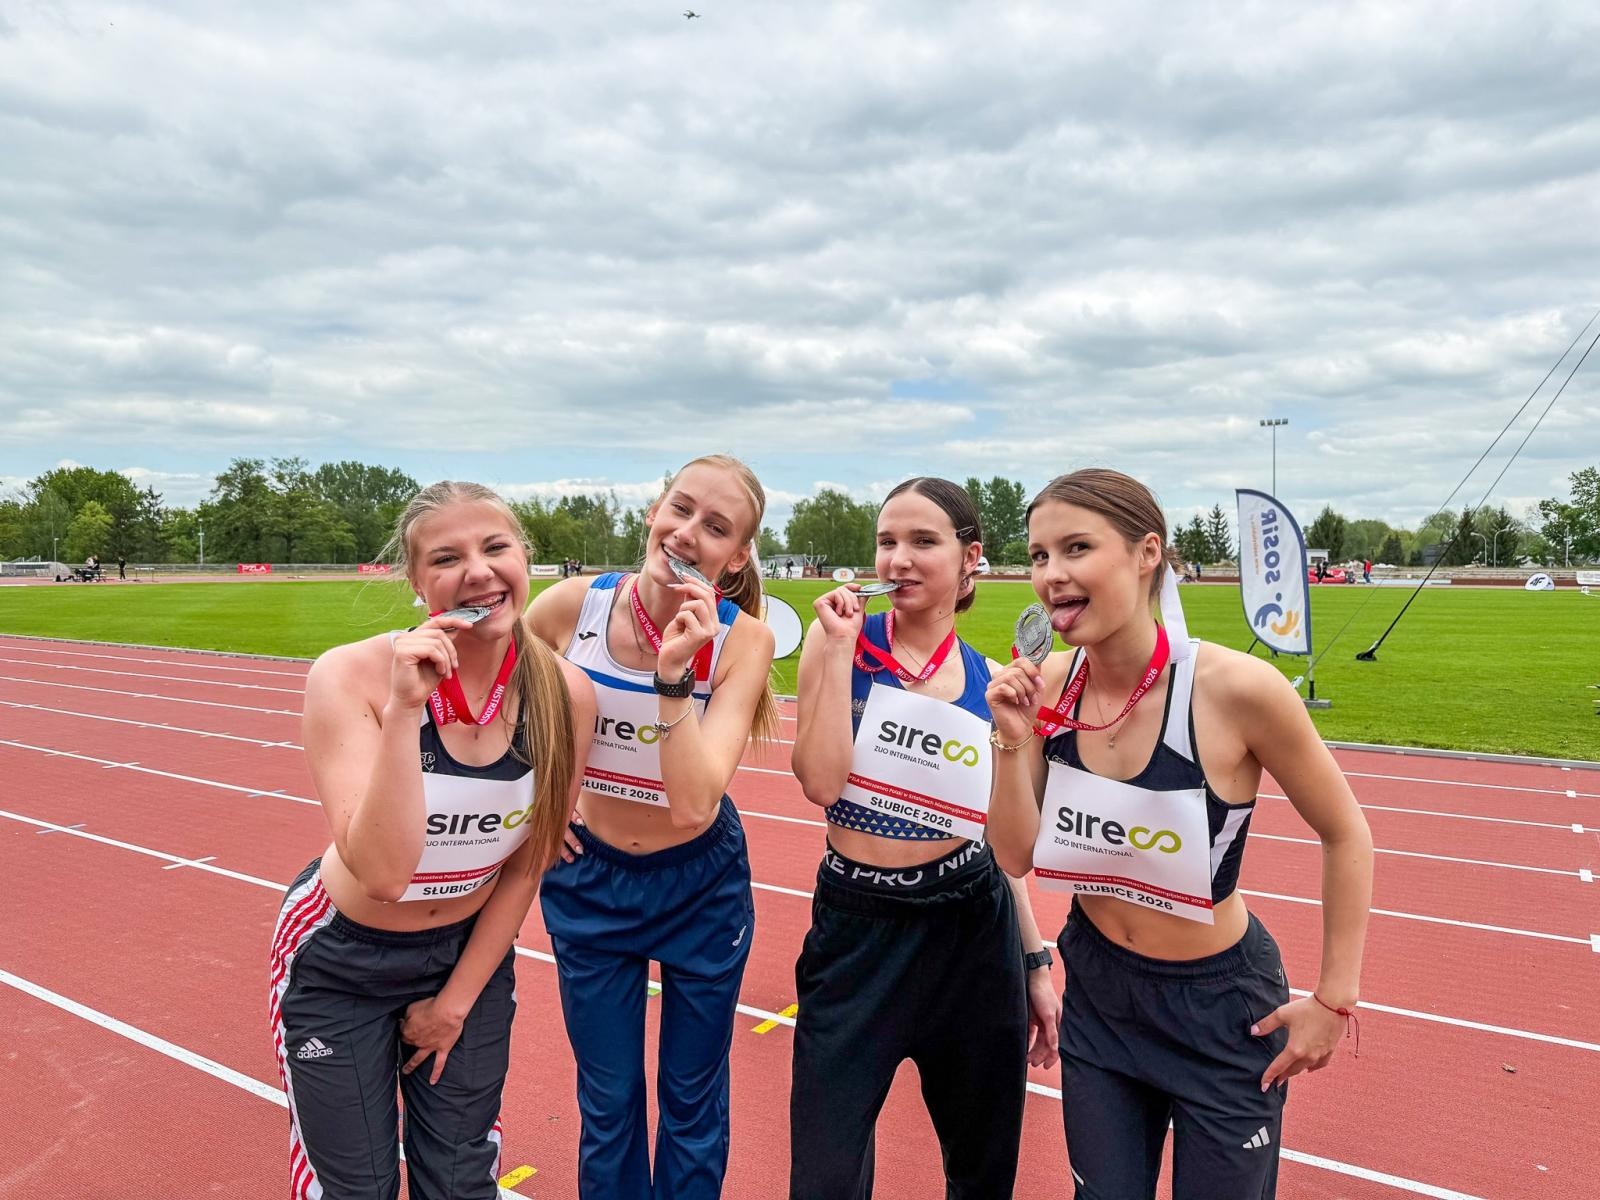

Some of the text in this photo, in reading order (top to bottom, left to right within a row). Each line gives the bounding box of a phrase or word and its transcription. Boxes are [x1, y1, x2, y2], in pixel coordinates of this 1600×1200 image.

[638, 610, 655, 636] POLSKI
[1142, 667, 1158, 689] 2026
[592, 738, 638, 753] TERNATIONAL
[878, 720, 979, 768] sireco
[874, 745, 940, 770] ZUO INTERNATIONAL
[629, 789, 659, 801] 2026
[870, 796, 953, 828] SŁUBICE 2026
[440, 836, 500, 847] INTERNATIONAL
[1055, 806, 1182, 854] sireco
[1054, 836, 1134, 858] ZUO INTERNATIONAL
[852, 866, 923, 886] PRO
[938, 838, 985, 877] NIK
[1073, 883, 1173, 910] SŁUBICE 2026
[297, 1047, 333, 1059] adidas
